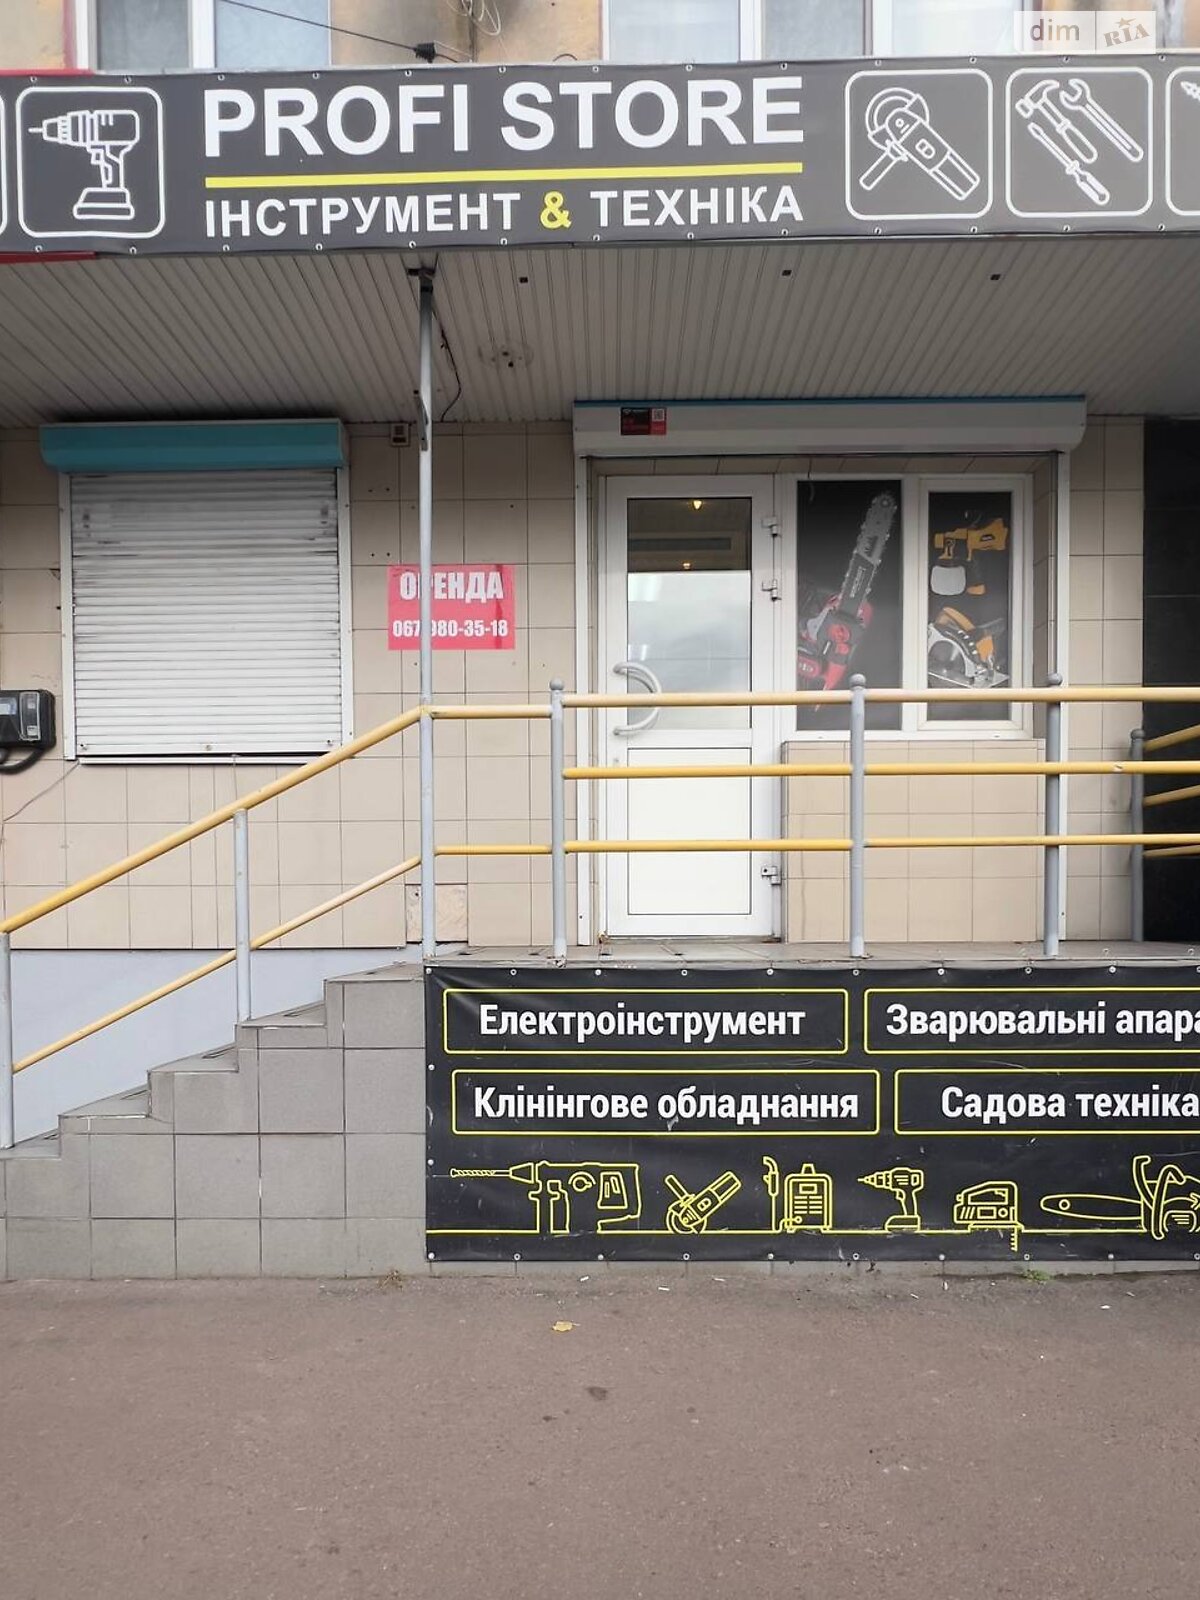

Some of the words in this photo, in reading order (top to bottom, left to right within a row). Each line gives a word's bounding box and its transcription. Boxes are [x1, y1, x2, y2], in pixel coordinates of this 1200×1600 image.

[205, 84, 469, 158] PROFI
[501, 76, 804, 151] STORE
[206, 192, 521, 238] ІНСТРУМЕНТ
[540, 191, 572, 230] &
[590, 185, 804, 228] ТЕХНІКА
[400, 571, 504, 603] ОЕНДА
[480, 1002, 806, 1044] Електроінструмент
[886, 1001, 1106, 1043] Зварювальні
[475, 1085, 649, 1119] Клінінгове
[658, 1085, 859, 1126] обладнання
[941, 1087, 1066, 1125] Садова
[1076, 1085, 1200, 1118] техніка
